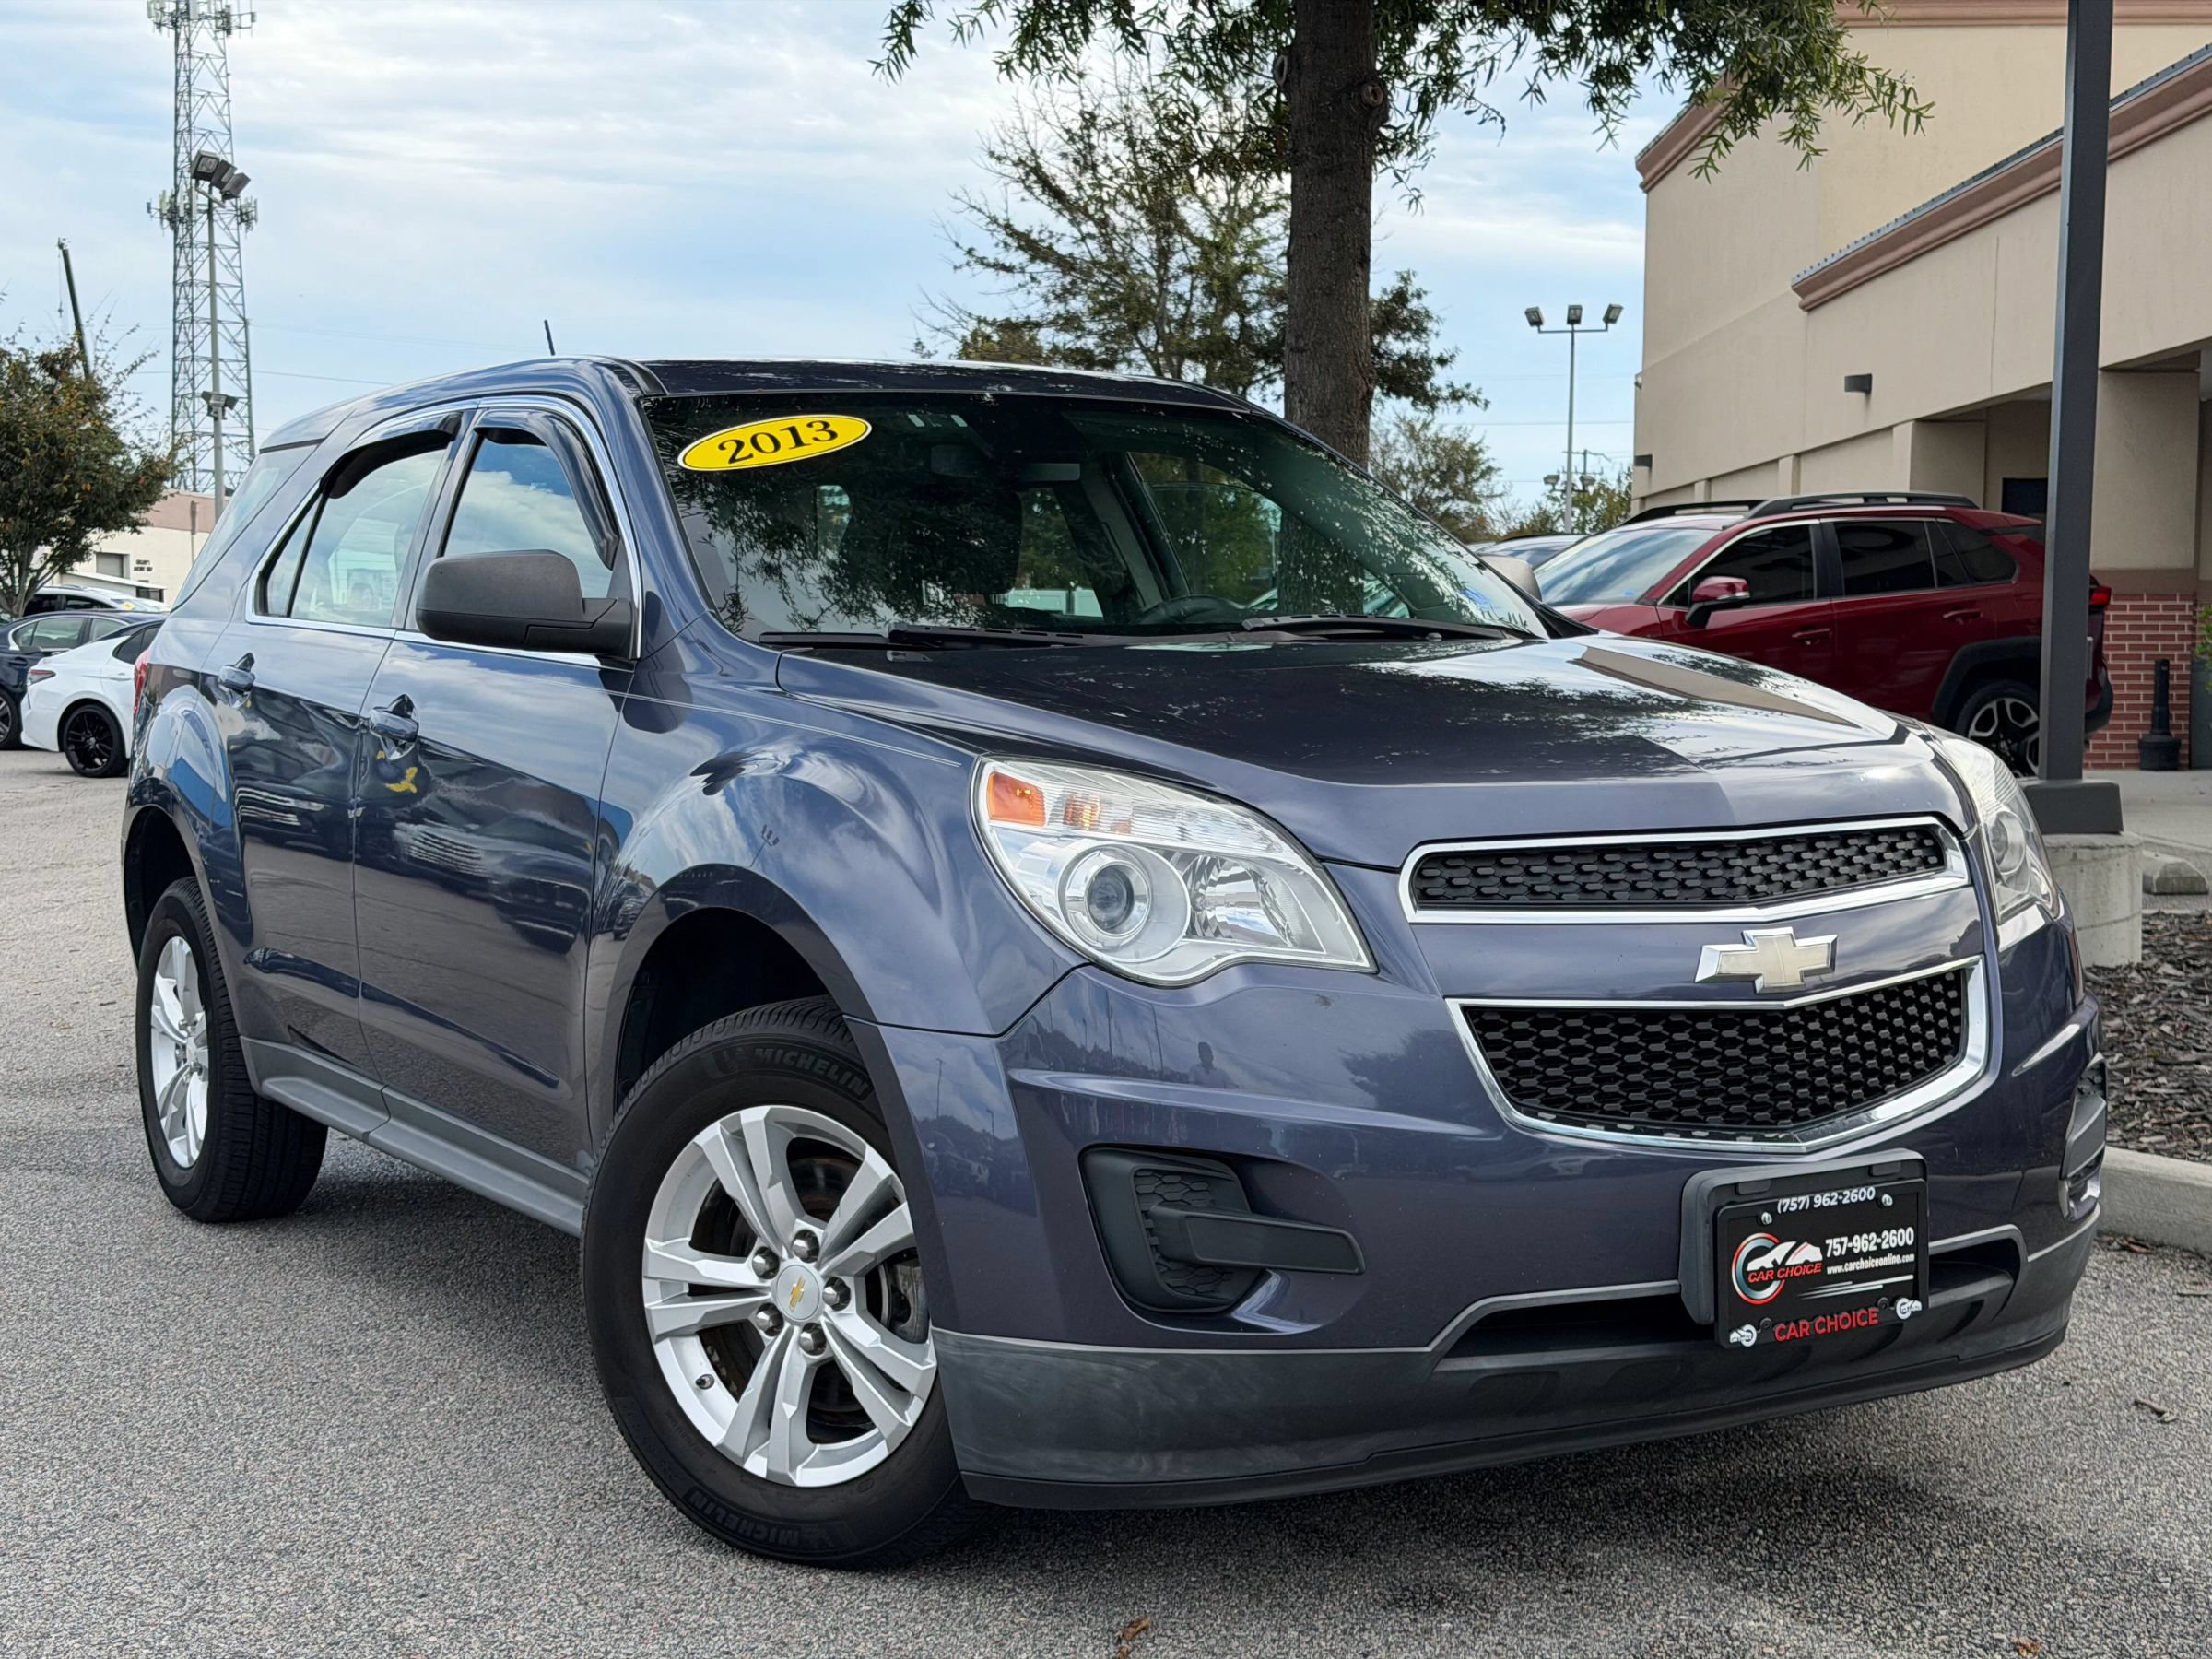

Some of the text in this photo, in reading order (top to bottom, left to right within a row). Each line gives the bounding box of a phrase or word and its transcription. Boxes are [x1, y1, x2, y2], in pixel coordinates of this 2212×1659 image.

[718, 420, 838, 465] 2013
[754, 1047, 870, 1095] MICHELIN
[1777, 1186, 1876, 1214] (757) 962-2600
[1825, 1227, 1914, 1257] 757-962-2600
[1747, 1263, 1823, 1283] CAR CHOICE
[1827, 1253, 1915, 1275] www.carchoiceonline.com
[1774, 1307, 1879, 1341] CAR CHOICE
[688, 1490, 799, 1546] MICHELIN
